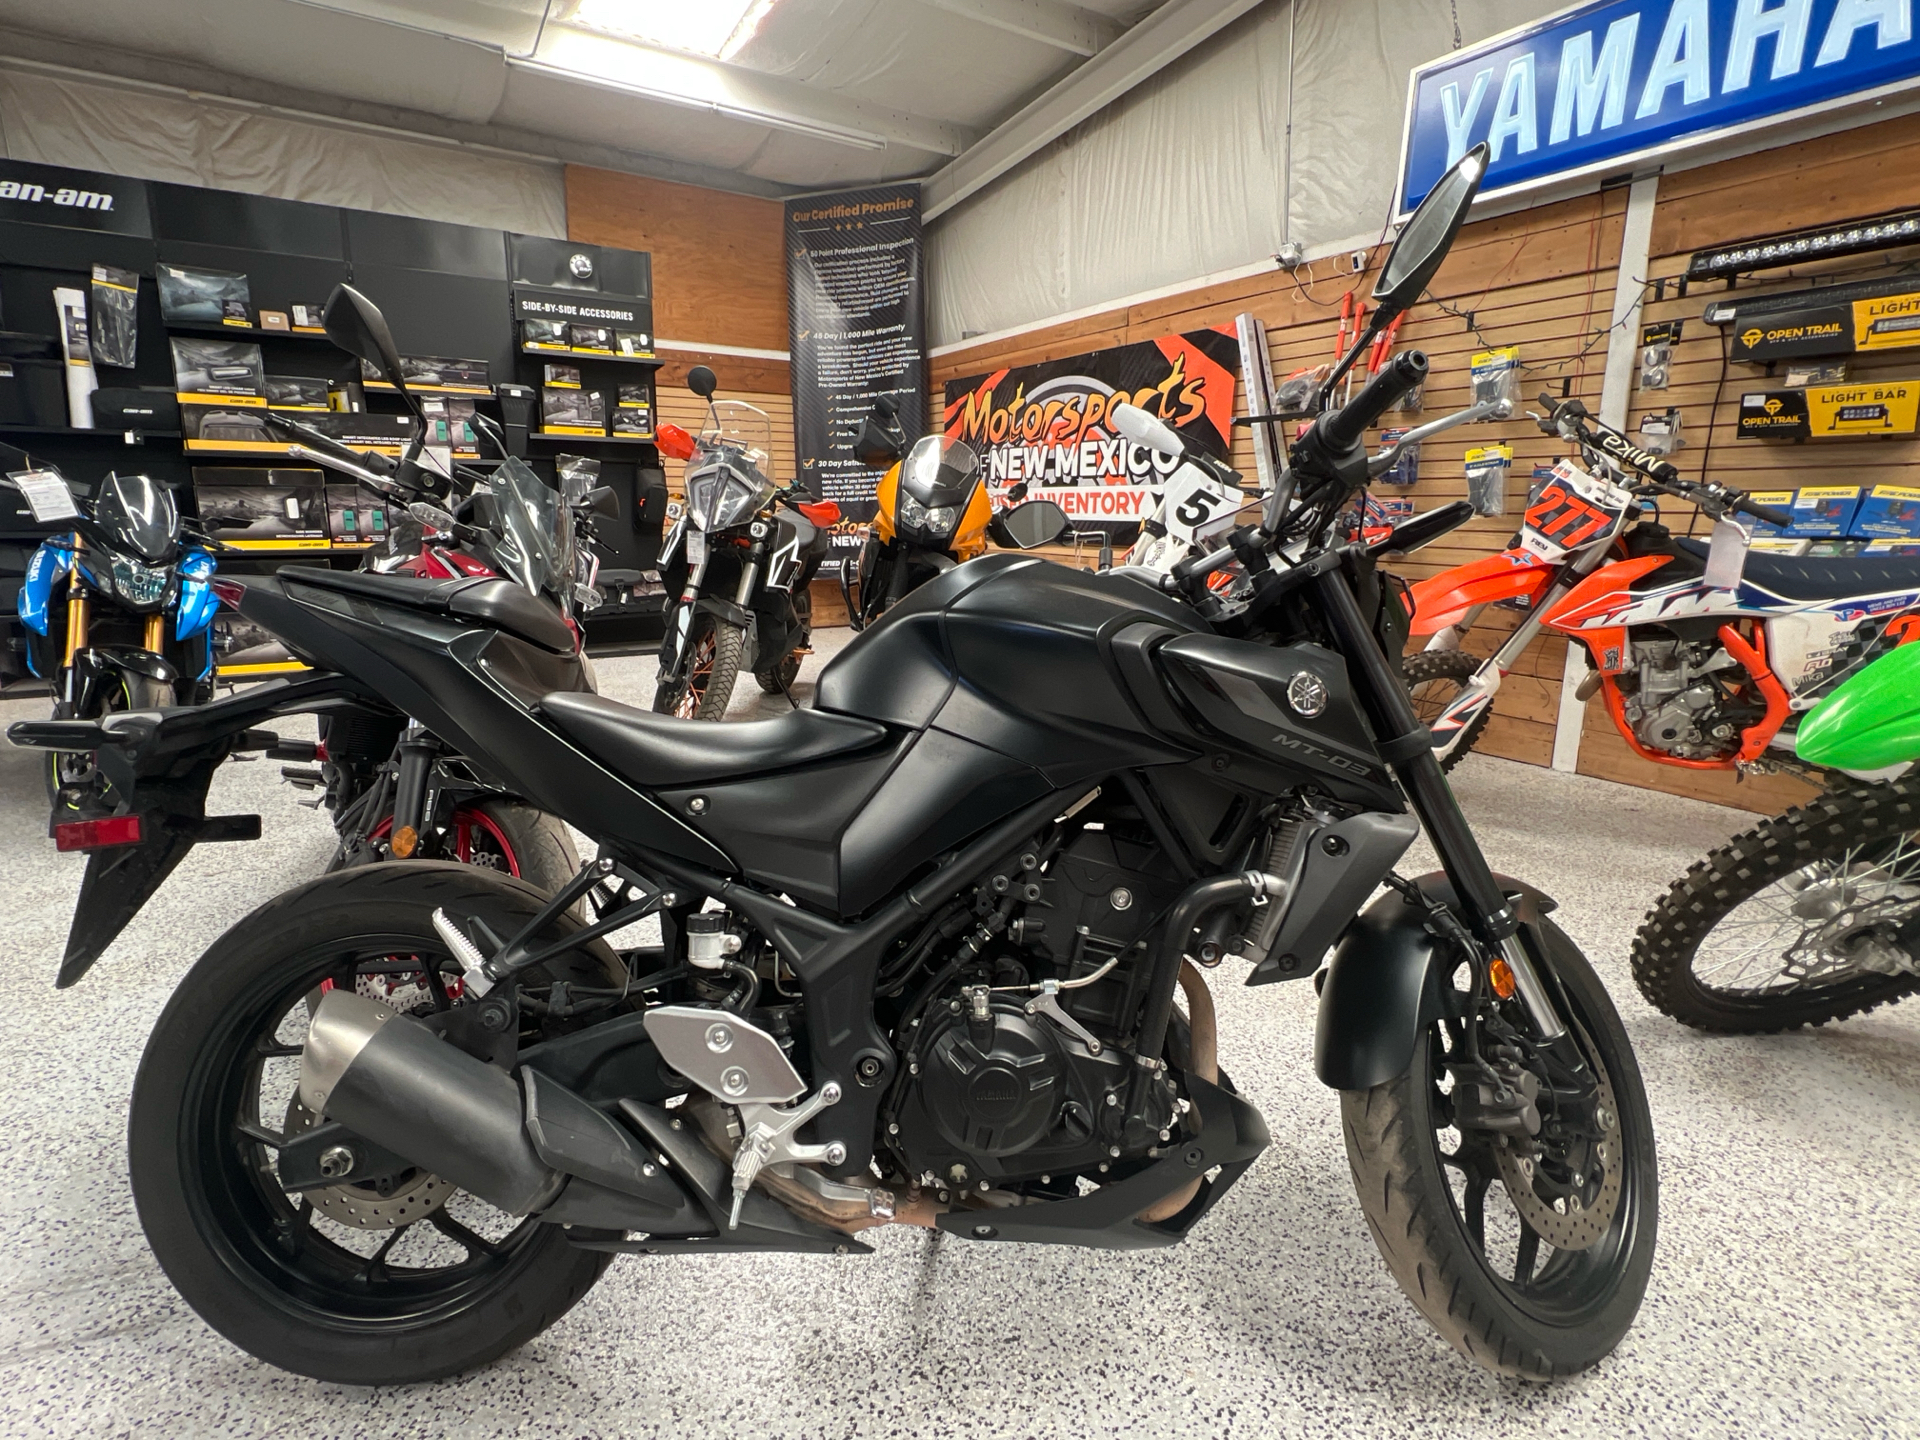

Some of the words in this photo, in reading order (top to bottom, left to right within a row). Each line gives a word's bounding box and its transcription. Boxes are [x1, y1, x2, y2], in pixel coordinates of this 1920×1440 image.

[1439, 0, 1911, 170] YAMAHA
[793, 211, 810, 222] Our
[812, 204, 860, 220] Certified
[862, 197, 914, 214] Promise
[818, 248, 834, 256] Point
[834, 244, 878, 255] Professional
[879, 237, 914, 250] Inspection
[522, 300, 577, 316] SIDE-BY-SIDE
[579, 307, 634, 321] ACCESSORIES
[824, 333, 838, 341] Day
[843, 331, 861, 340] 1,000
[862, 329, 875, 337] Mile
[875, 324, 906, 335] Warranty
[1766, 327, 1804, 340] OPEN
[1806, 322, 1843, 335] TRAIL
[1821, 392, 1868, 404] LIGHT
[1873, 389, 1907, 400] BAR
[1742, 416, 1771, 426] OPEN
[1772, 414, 1801, 424] TRAIL
[990, 444, 1049, 481] NEW
[1055, 437, 1180, 478] MEXICO
[1034, 491, 1145, 515] INVENTORY
[1175, 488, 1222, 528] 5
[1525, 486, 1613, 548] 277
[832, 536, 862, 547] NEW
[1791, 672, 1824, 687] Mika
[1272, 733, 1372, 777] MT-03
